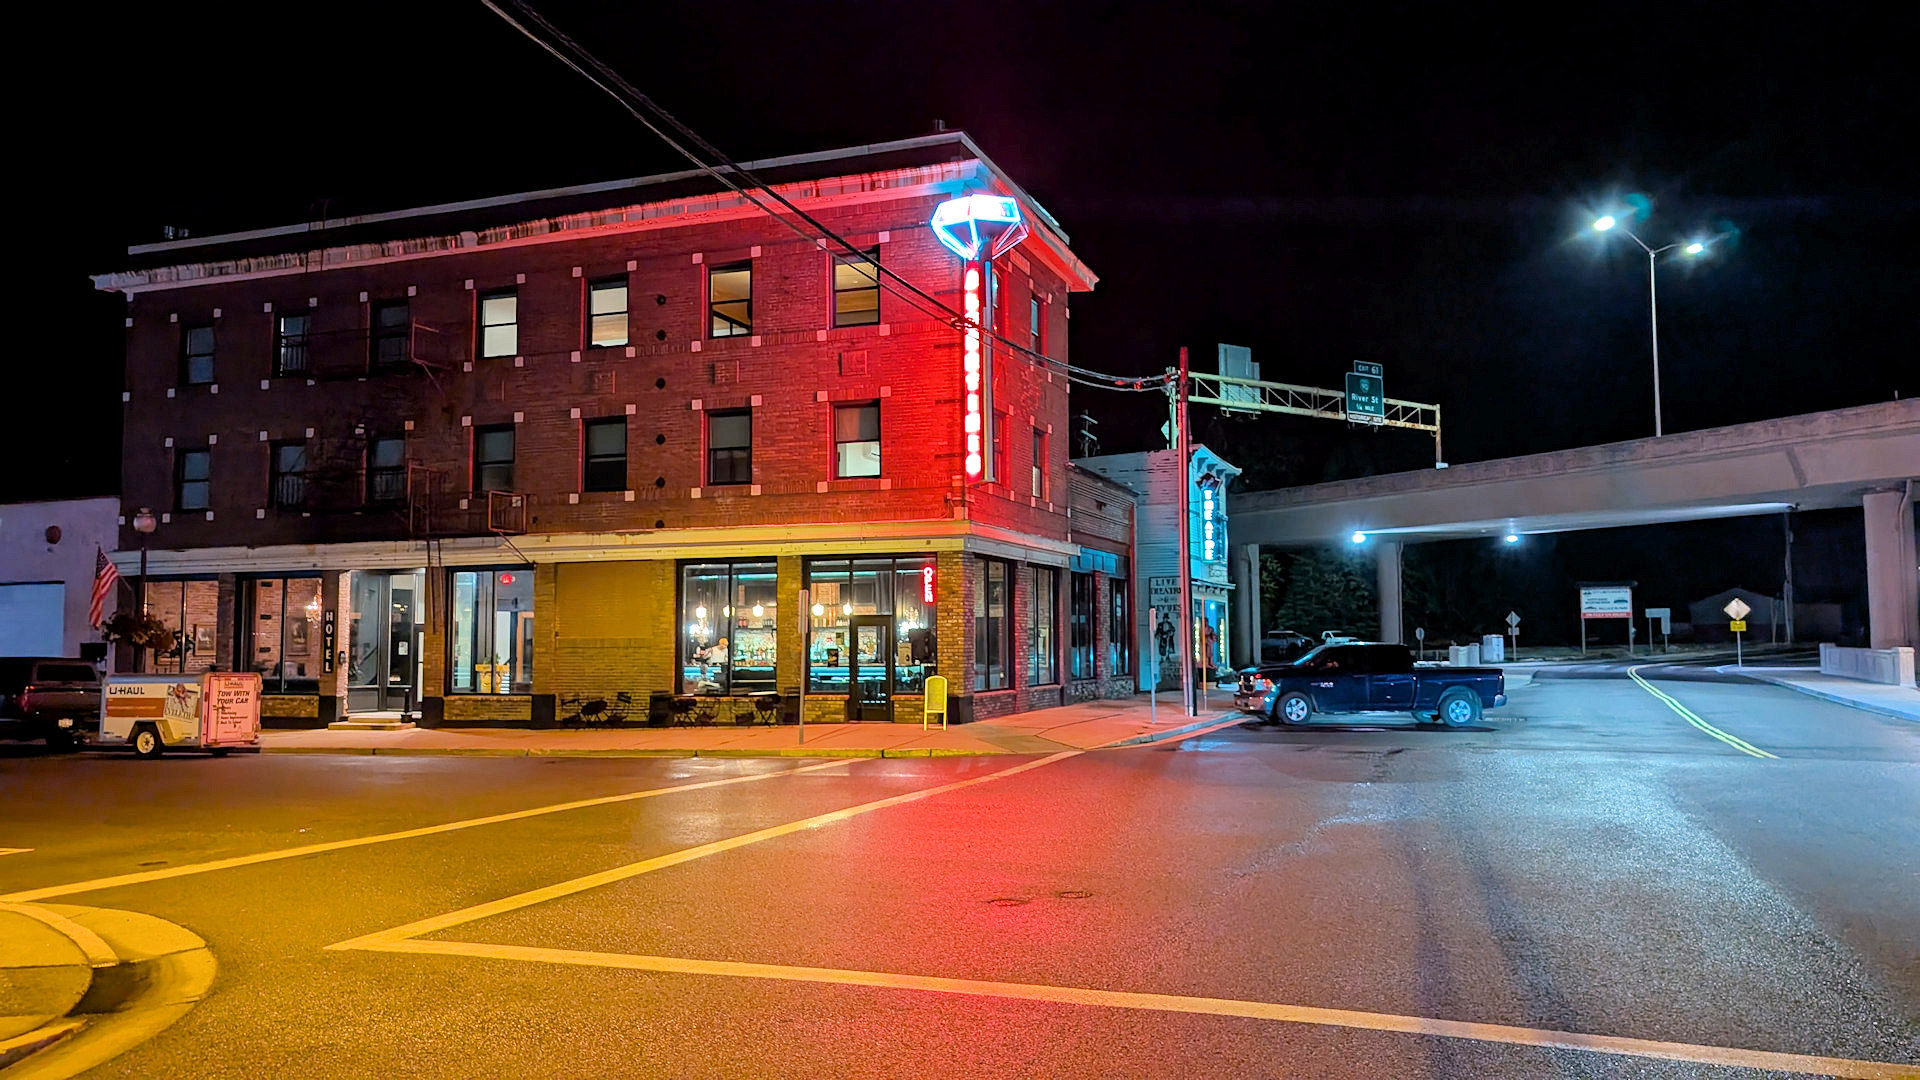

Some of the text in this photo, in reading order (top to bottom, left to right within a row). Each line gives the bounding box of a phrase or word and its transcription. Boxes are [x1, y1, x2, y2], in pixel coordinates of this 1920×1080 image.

[1351, 393, 1379, 404] River St
[1203, 489, 1215, 560] THEATRE
[923, 566, 933, 602] OPEN
[1155, 578, 1177, 586] LIVE
[325, 611, 334, 672] HOTEL
